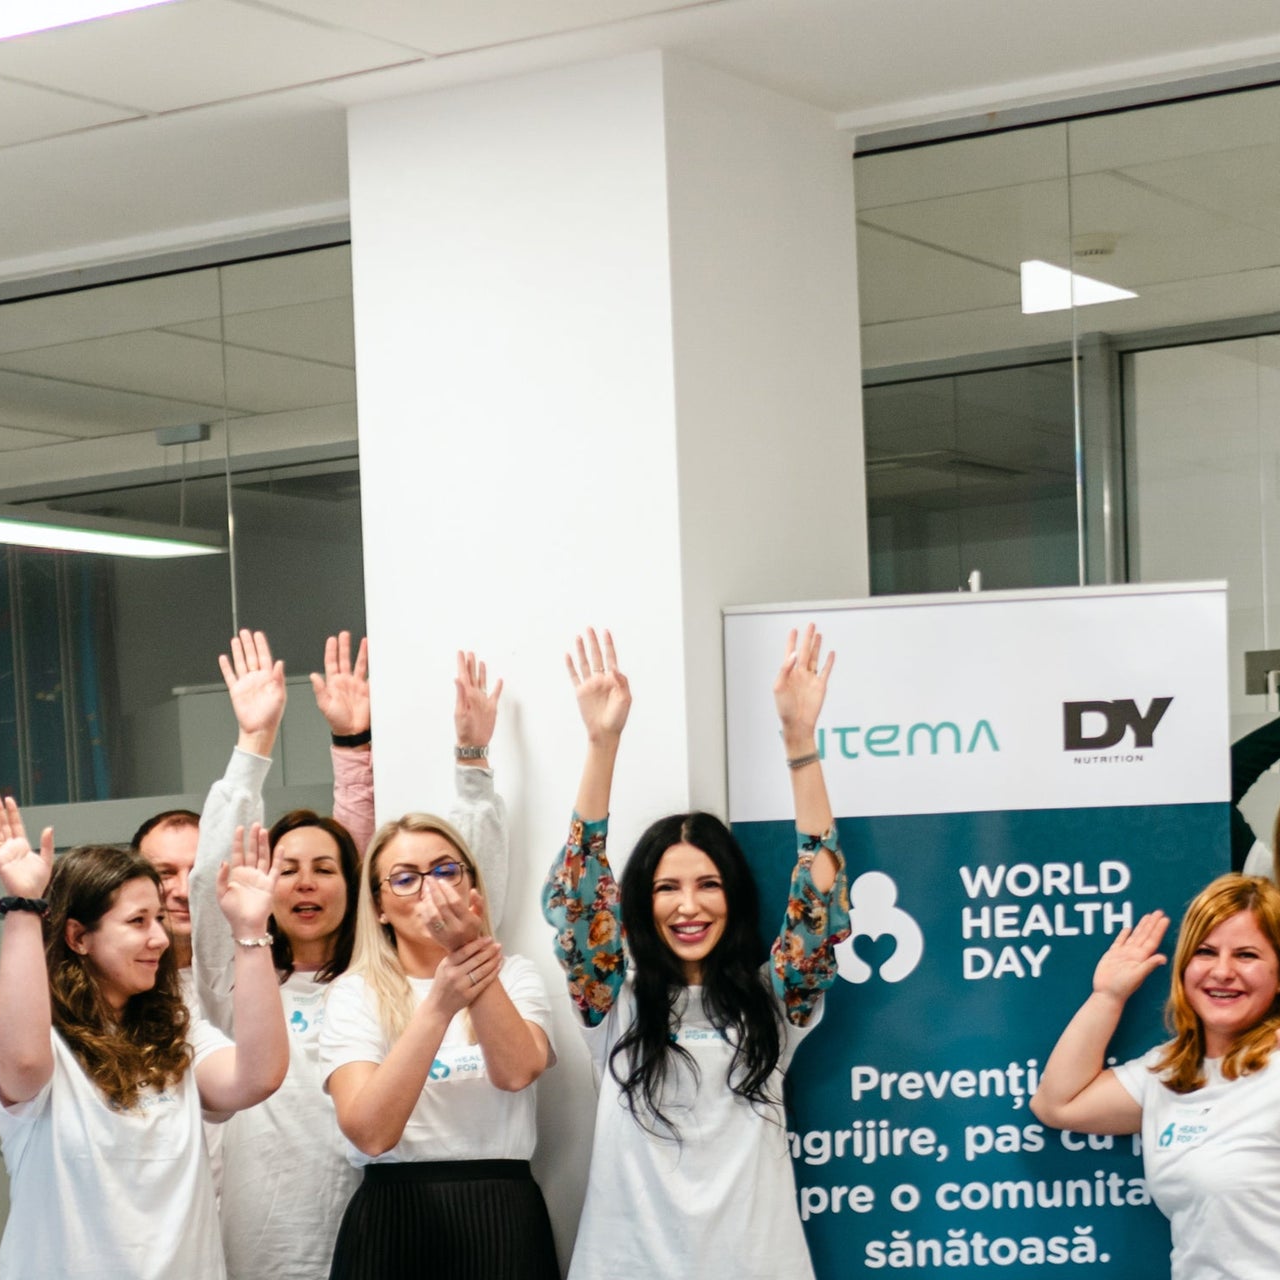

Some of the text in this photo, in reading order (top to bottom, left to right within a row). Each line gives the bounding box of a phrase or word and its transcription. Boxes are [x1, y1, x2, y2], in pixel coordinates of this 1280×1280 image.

[1063, 696, 1174, 751] DY
[1073, 754, 1144, 765] NUTRITION
[959, 860, 1131, 899] WORLD
[962, 901, 1133, 940] HEALTH
[963, 944, 1052, 980] DAY
[851, 1058, 1044, 1110] Prevenți
[787, 1119, 949, 1166] ngrijire,
[965, 1123, 1045, 1162] pas
[800, 1169, 1152, 1222] pre o comunita
[864, 1225, 1111, 1269] sănătoasă.
